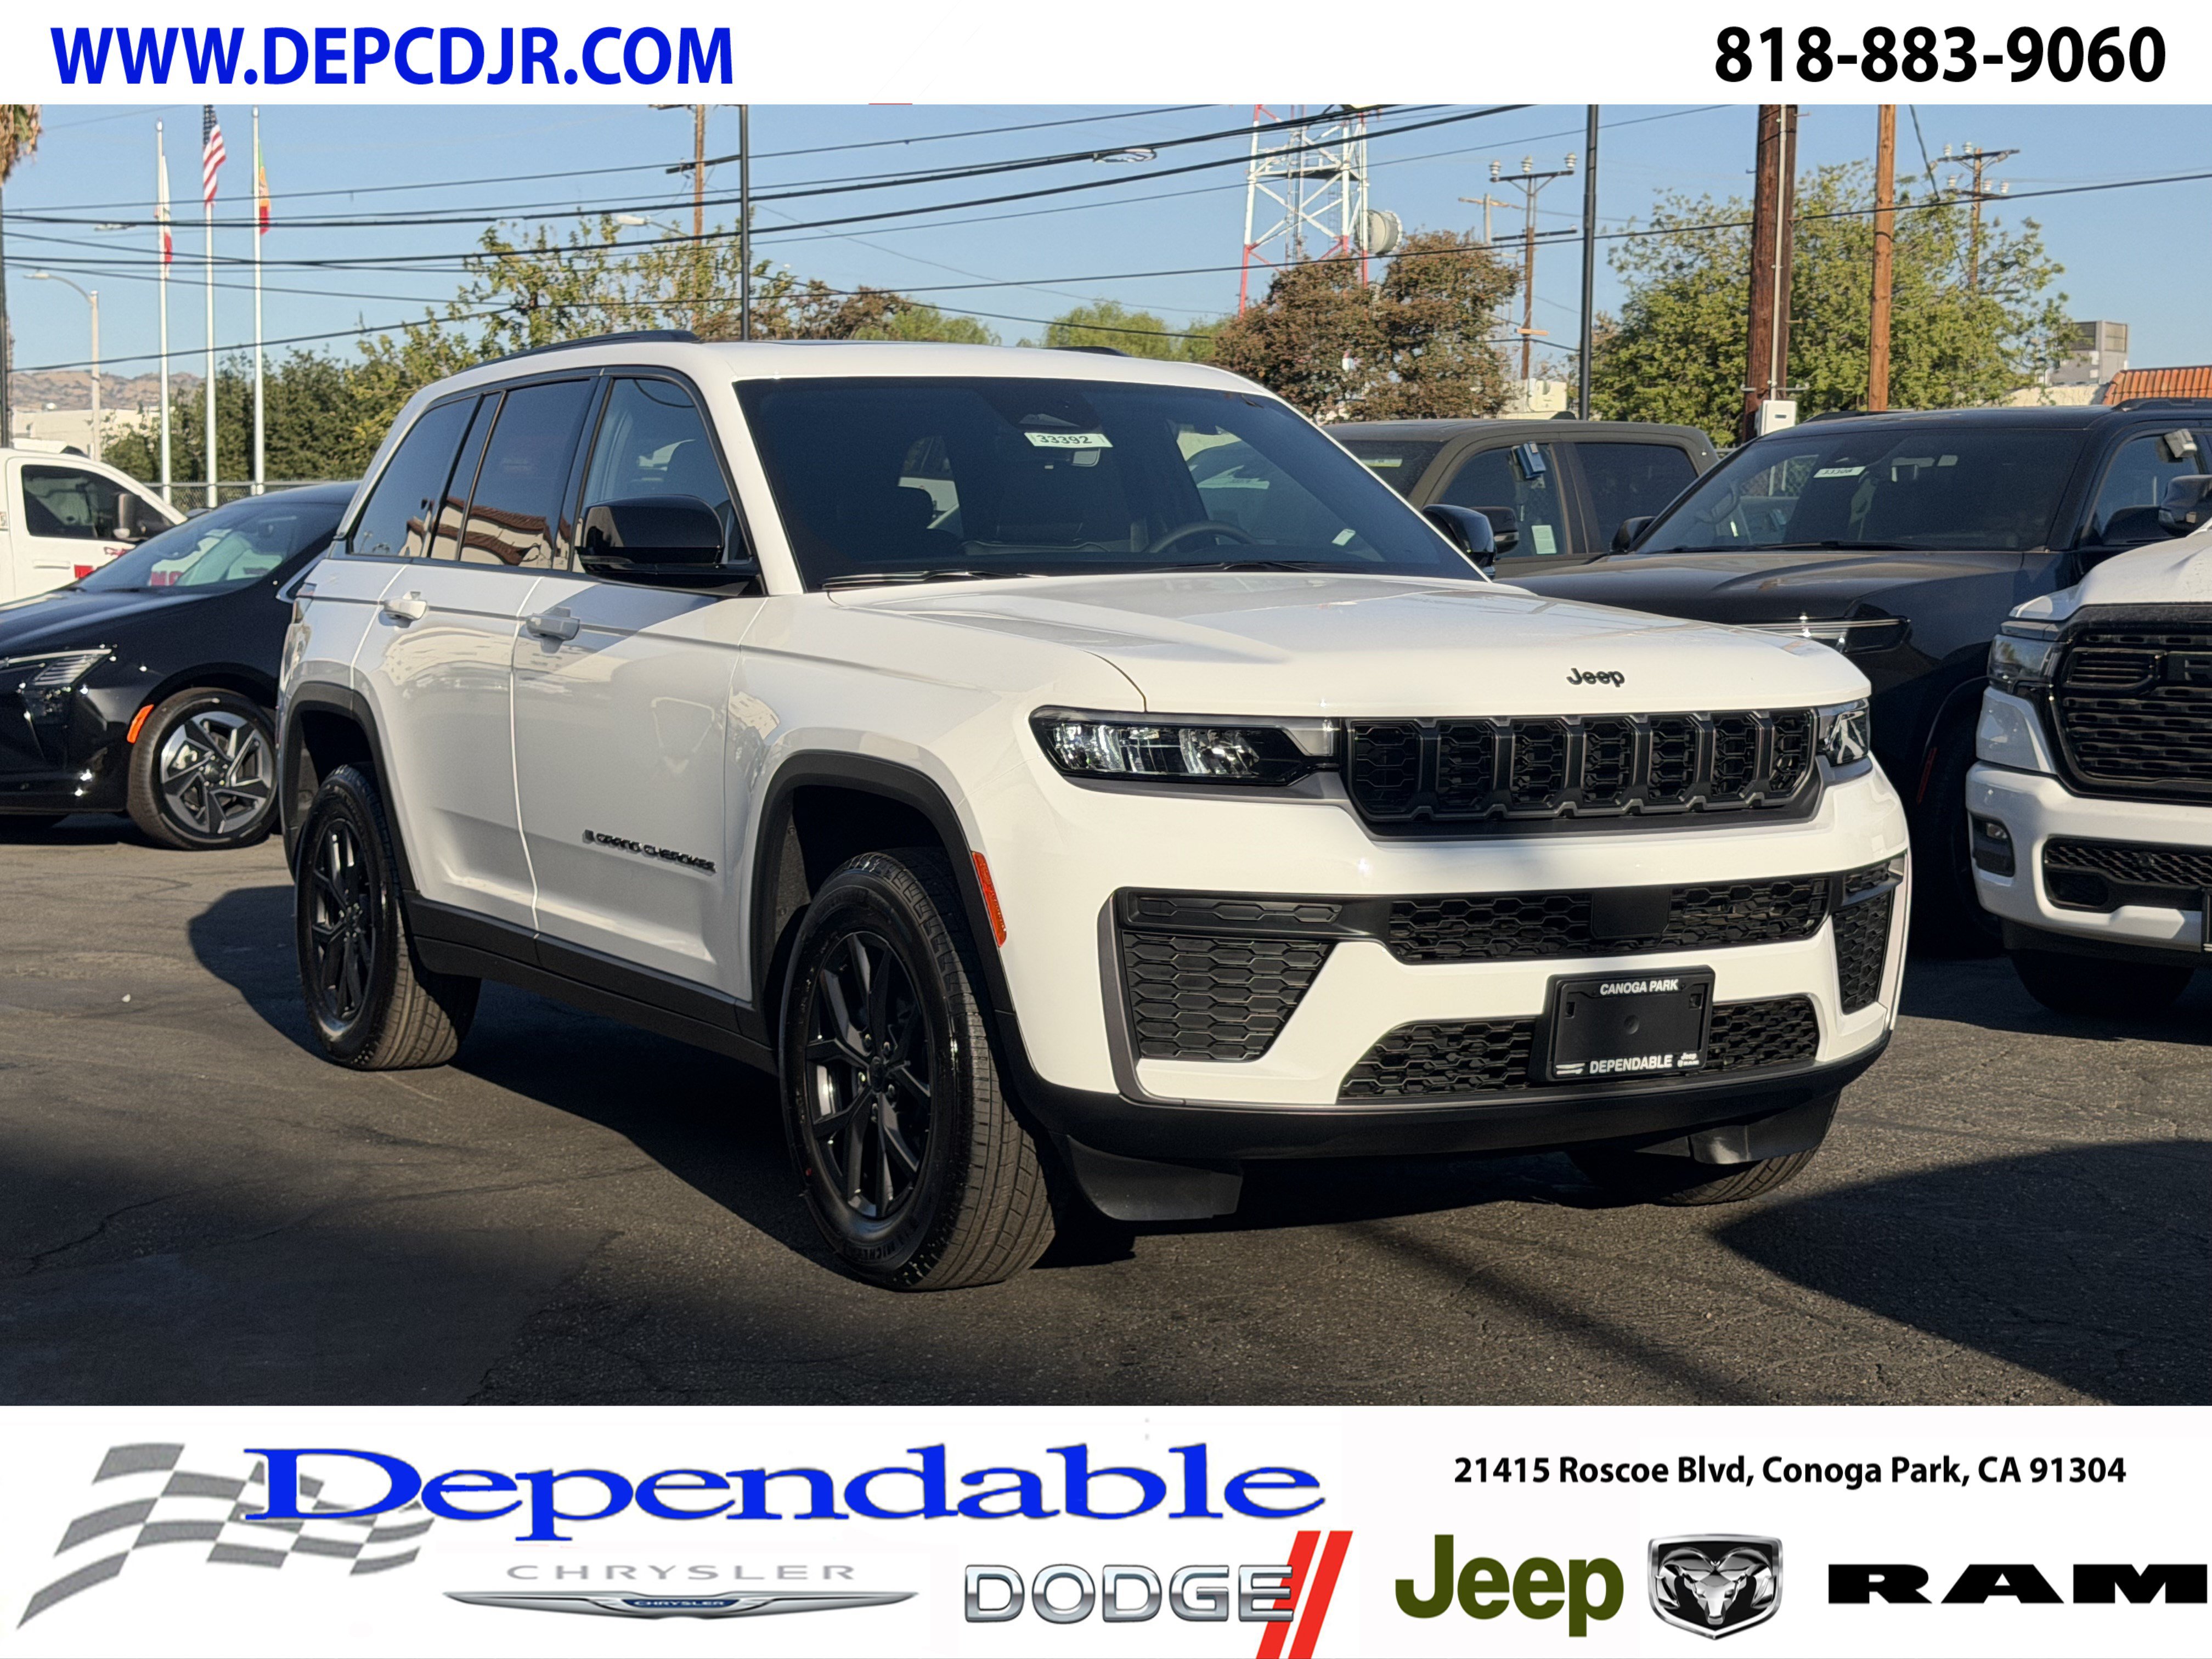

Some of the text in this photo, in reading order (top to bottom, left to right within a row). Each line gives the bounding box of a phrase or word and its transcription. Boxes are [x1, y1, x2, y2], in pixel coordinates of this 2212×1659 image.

[1036, 435, 1092, 444] 33392
[1567, 668, 1625, 687] Jeep
[1600, 979, 1679, 996] CANOGA PARK
[1590, 1054, 1673, 1074] DEPENDABLE
